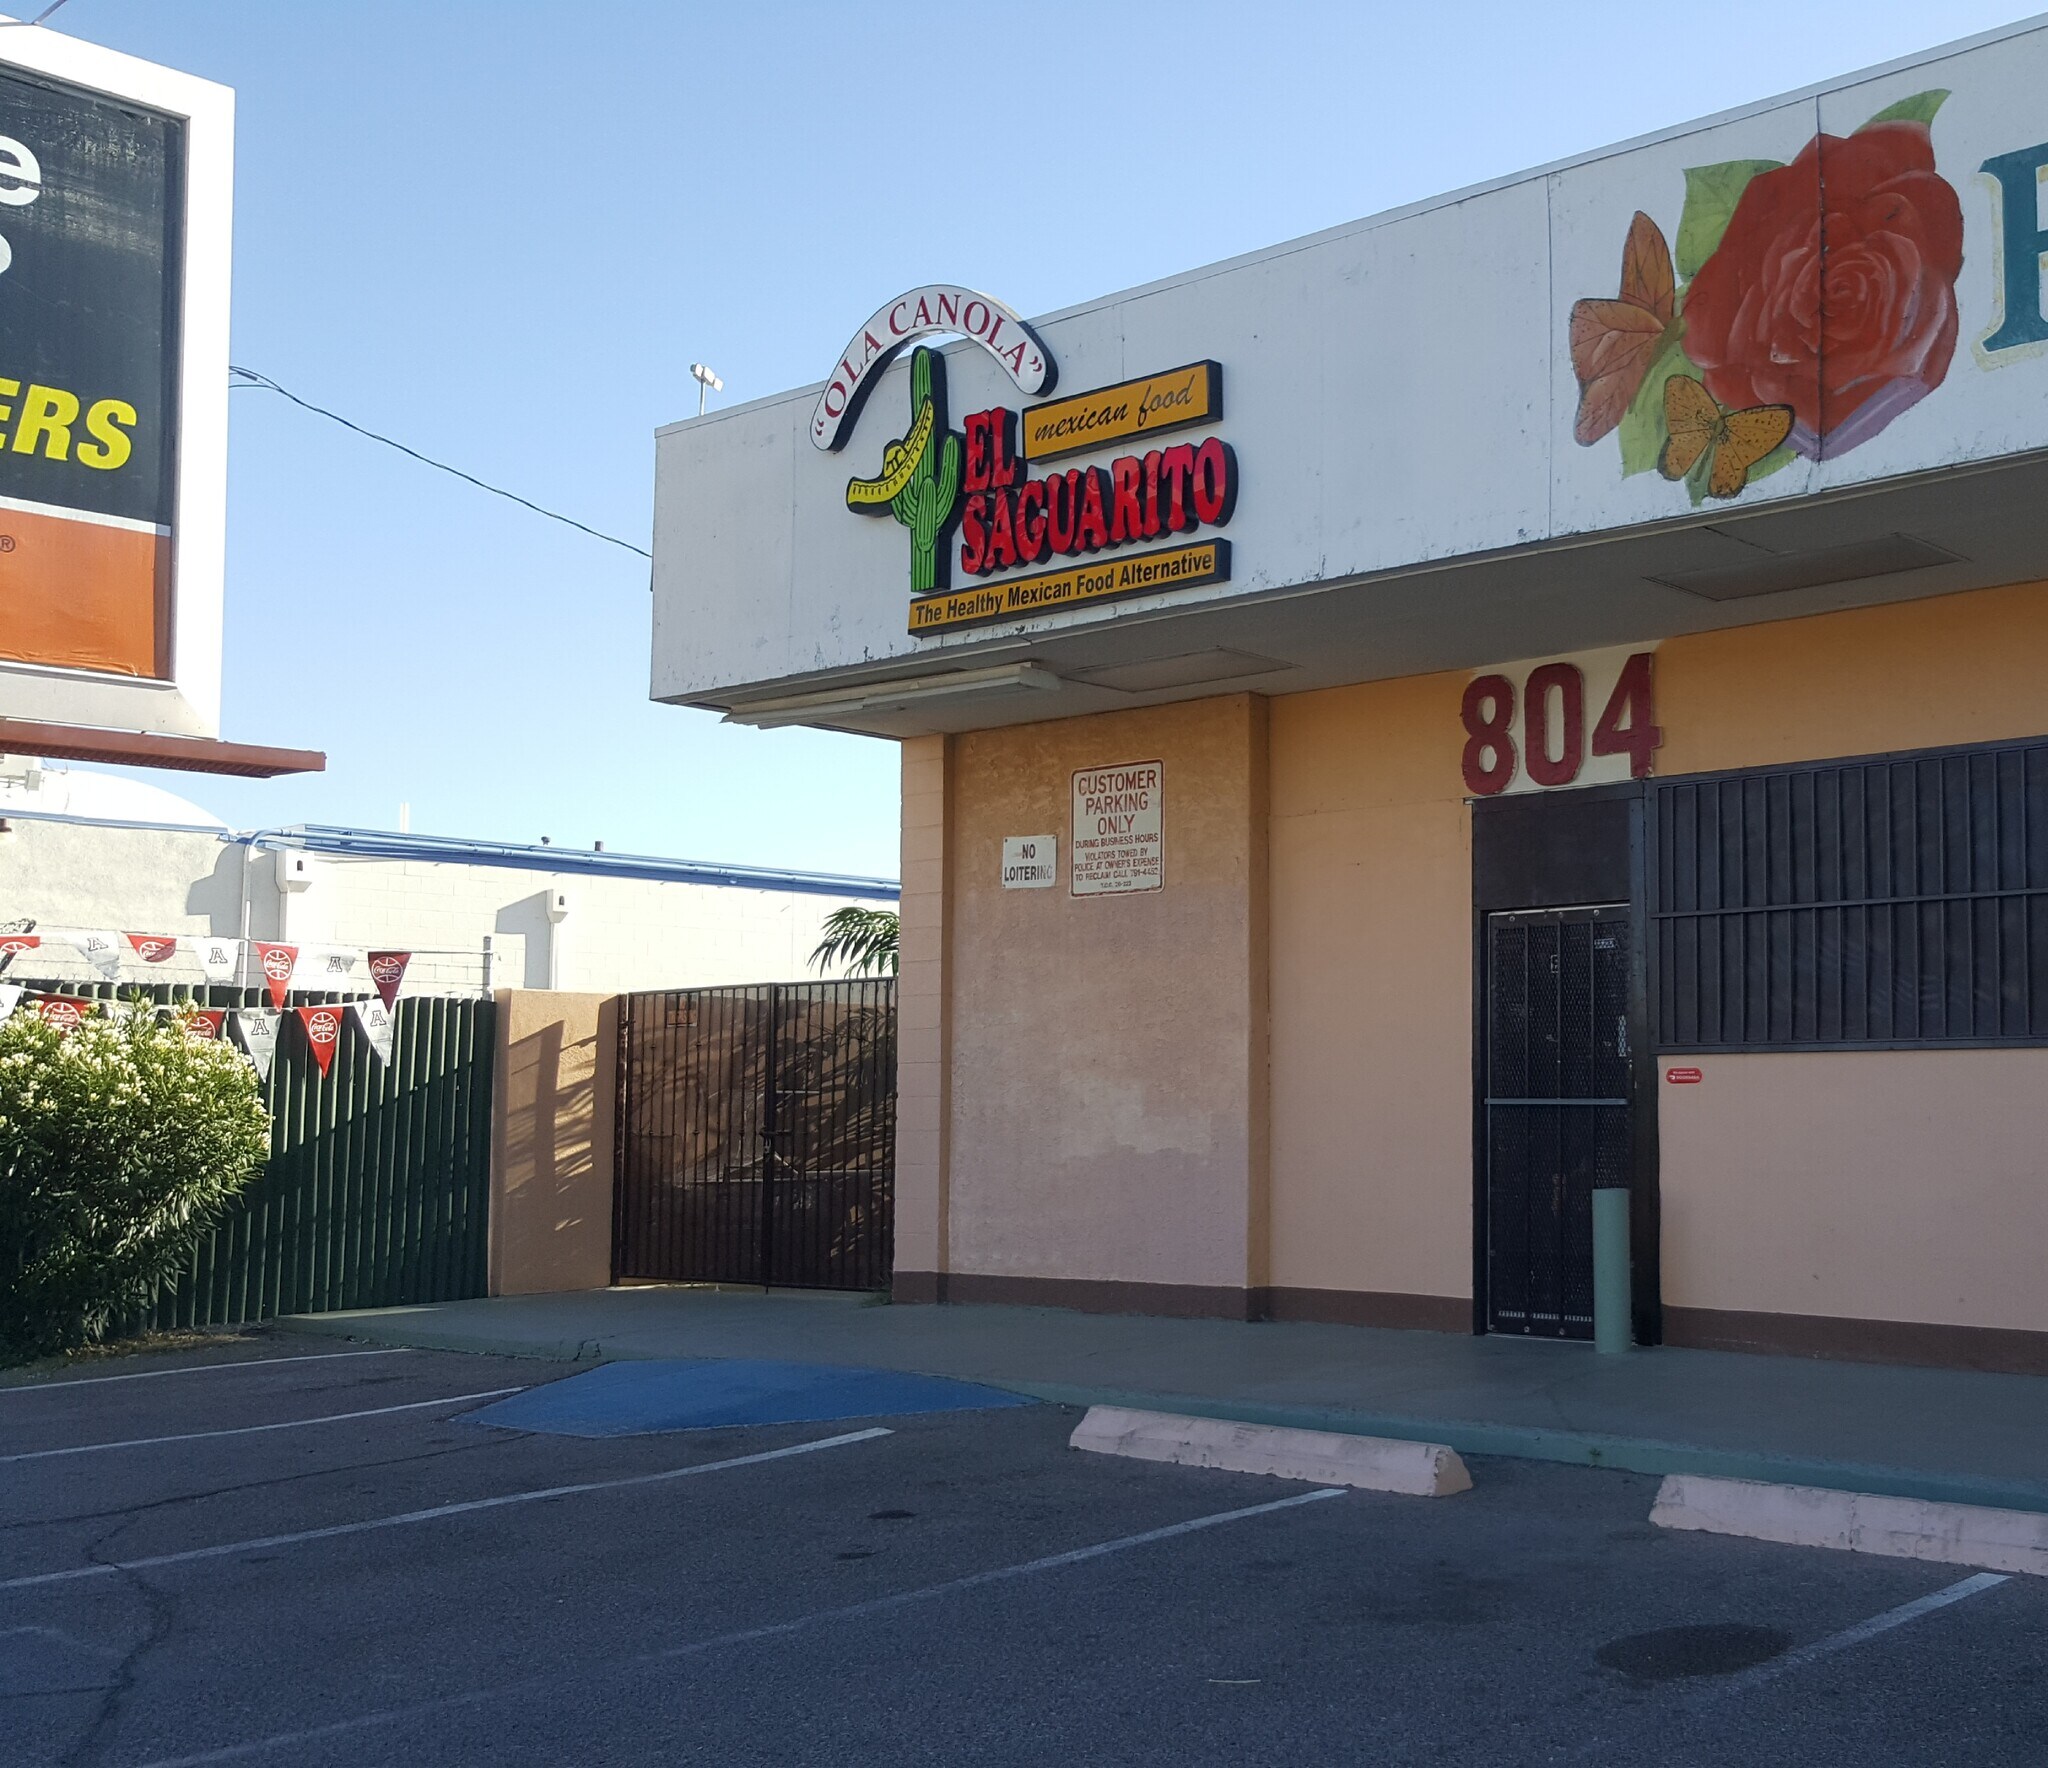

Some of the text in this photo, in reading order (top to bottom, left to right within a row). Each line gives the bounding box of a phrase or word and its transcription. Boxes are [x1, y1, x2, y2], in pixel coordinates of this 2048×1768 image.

[1035, 374, 1196, 442] mexican food
[963, 406, 1017, 494] EL
[961, 436, 1227, 575] SAGUARITO
[916, 551, 1212, 625] The Healthy Mexican Food Alternative
[1461, 652, 1662, 796] 804
[1078, 769, 1157, 796] CUSTOMER
[1085, 791, 1149, 816] PARKING
[1097, 814, 1136, 835] ONLY
[1075, 833, 1159, 849] DURING BUSINESS HOURS
[1022, 843, 1036, 859] NO
[1084, 847, 1149, 861] VIOLATORS TOWED BY
[1004, 864, 1053, 882] LOITERING
[1074, 861, 1095, 872] POLICE
[1096, 861, 1103, 870] AT
[1132, 856, 1160, 867] EXPENSE
[1075, 873, 1084, 882] TO
[1085, 870, 1111, 881] RECLAIM
[1113, 868, 1128, 879] CALL
[209, 947, 228, 964] A
[326, 956, 343, 973] A
[251, 1018, 270, 1036] A
[370, 1010, 387, 1027] A
